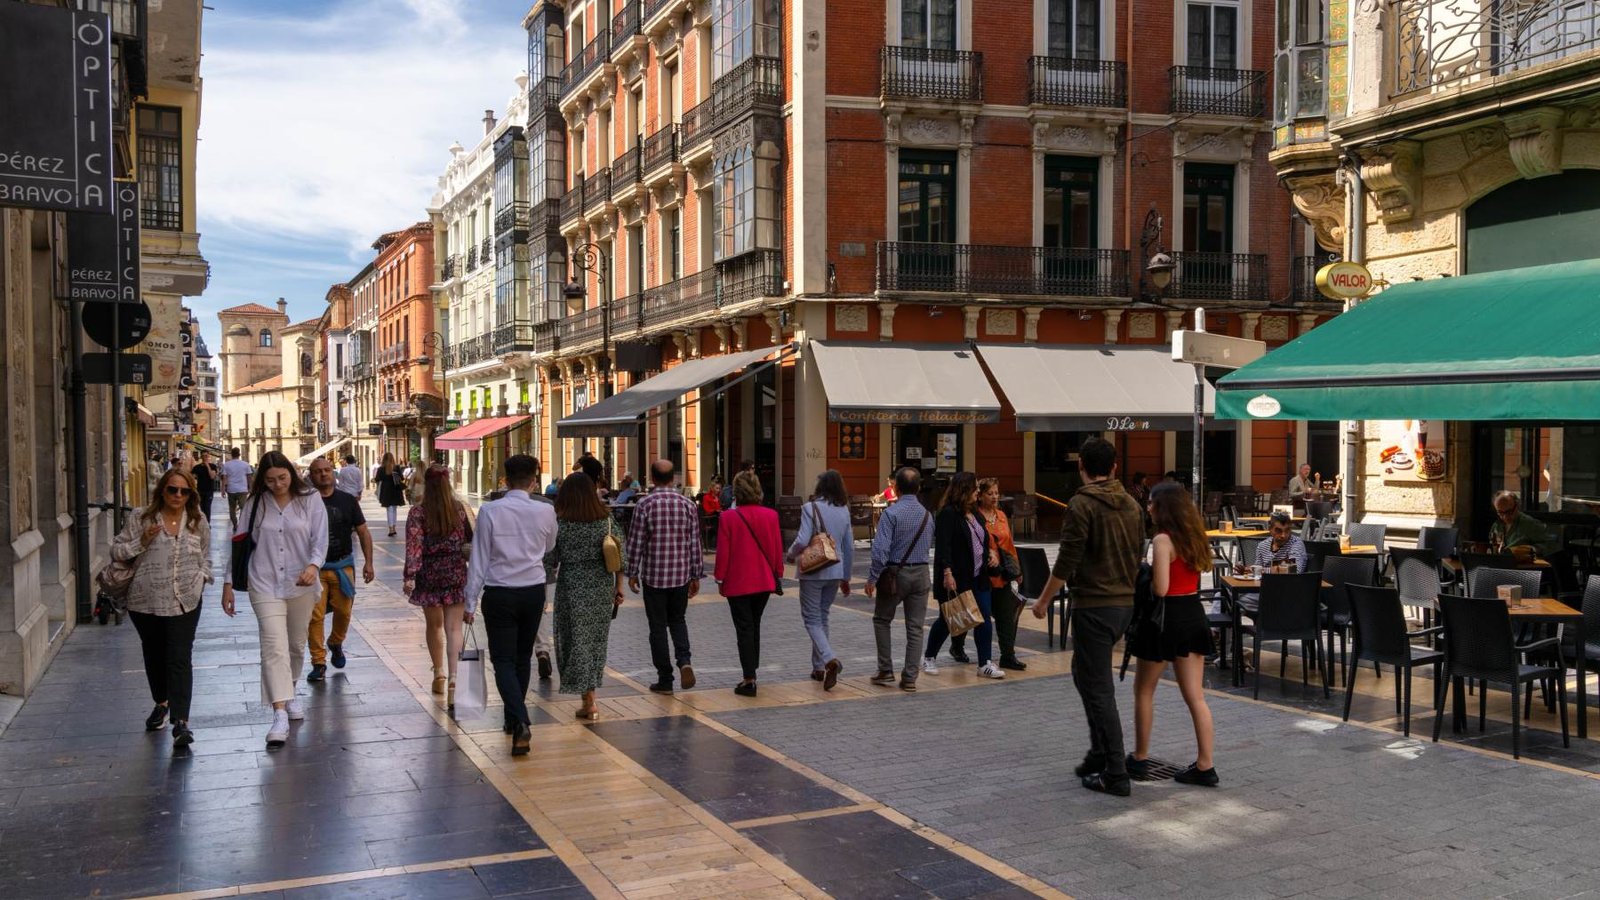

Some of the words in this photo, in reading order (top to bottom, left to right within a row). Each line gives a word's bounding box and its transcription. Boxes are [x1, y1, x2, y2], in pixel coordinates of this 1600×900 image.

[78, 19, 104, 206] ÓPTICA
[0, 151, 64, 174] PÉREZ
[0, 184, 72, 204] BRAVO
[120, 185, 136, 300] ÓPTICA
[71, 268, 112, 280] PÉREZ
[1331, 273, 1367, 288] VALOR
[71, 287, 116, 299] BRAVO
